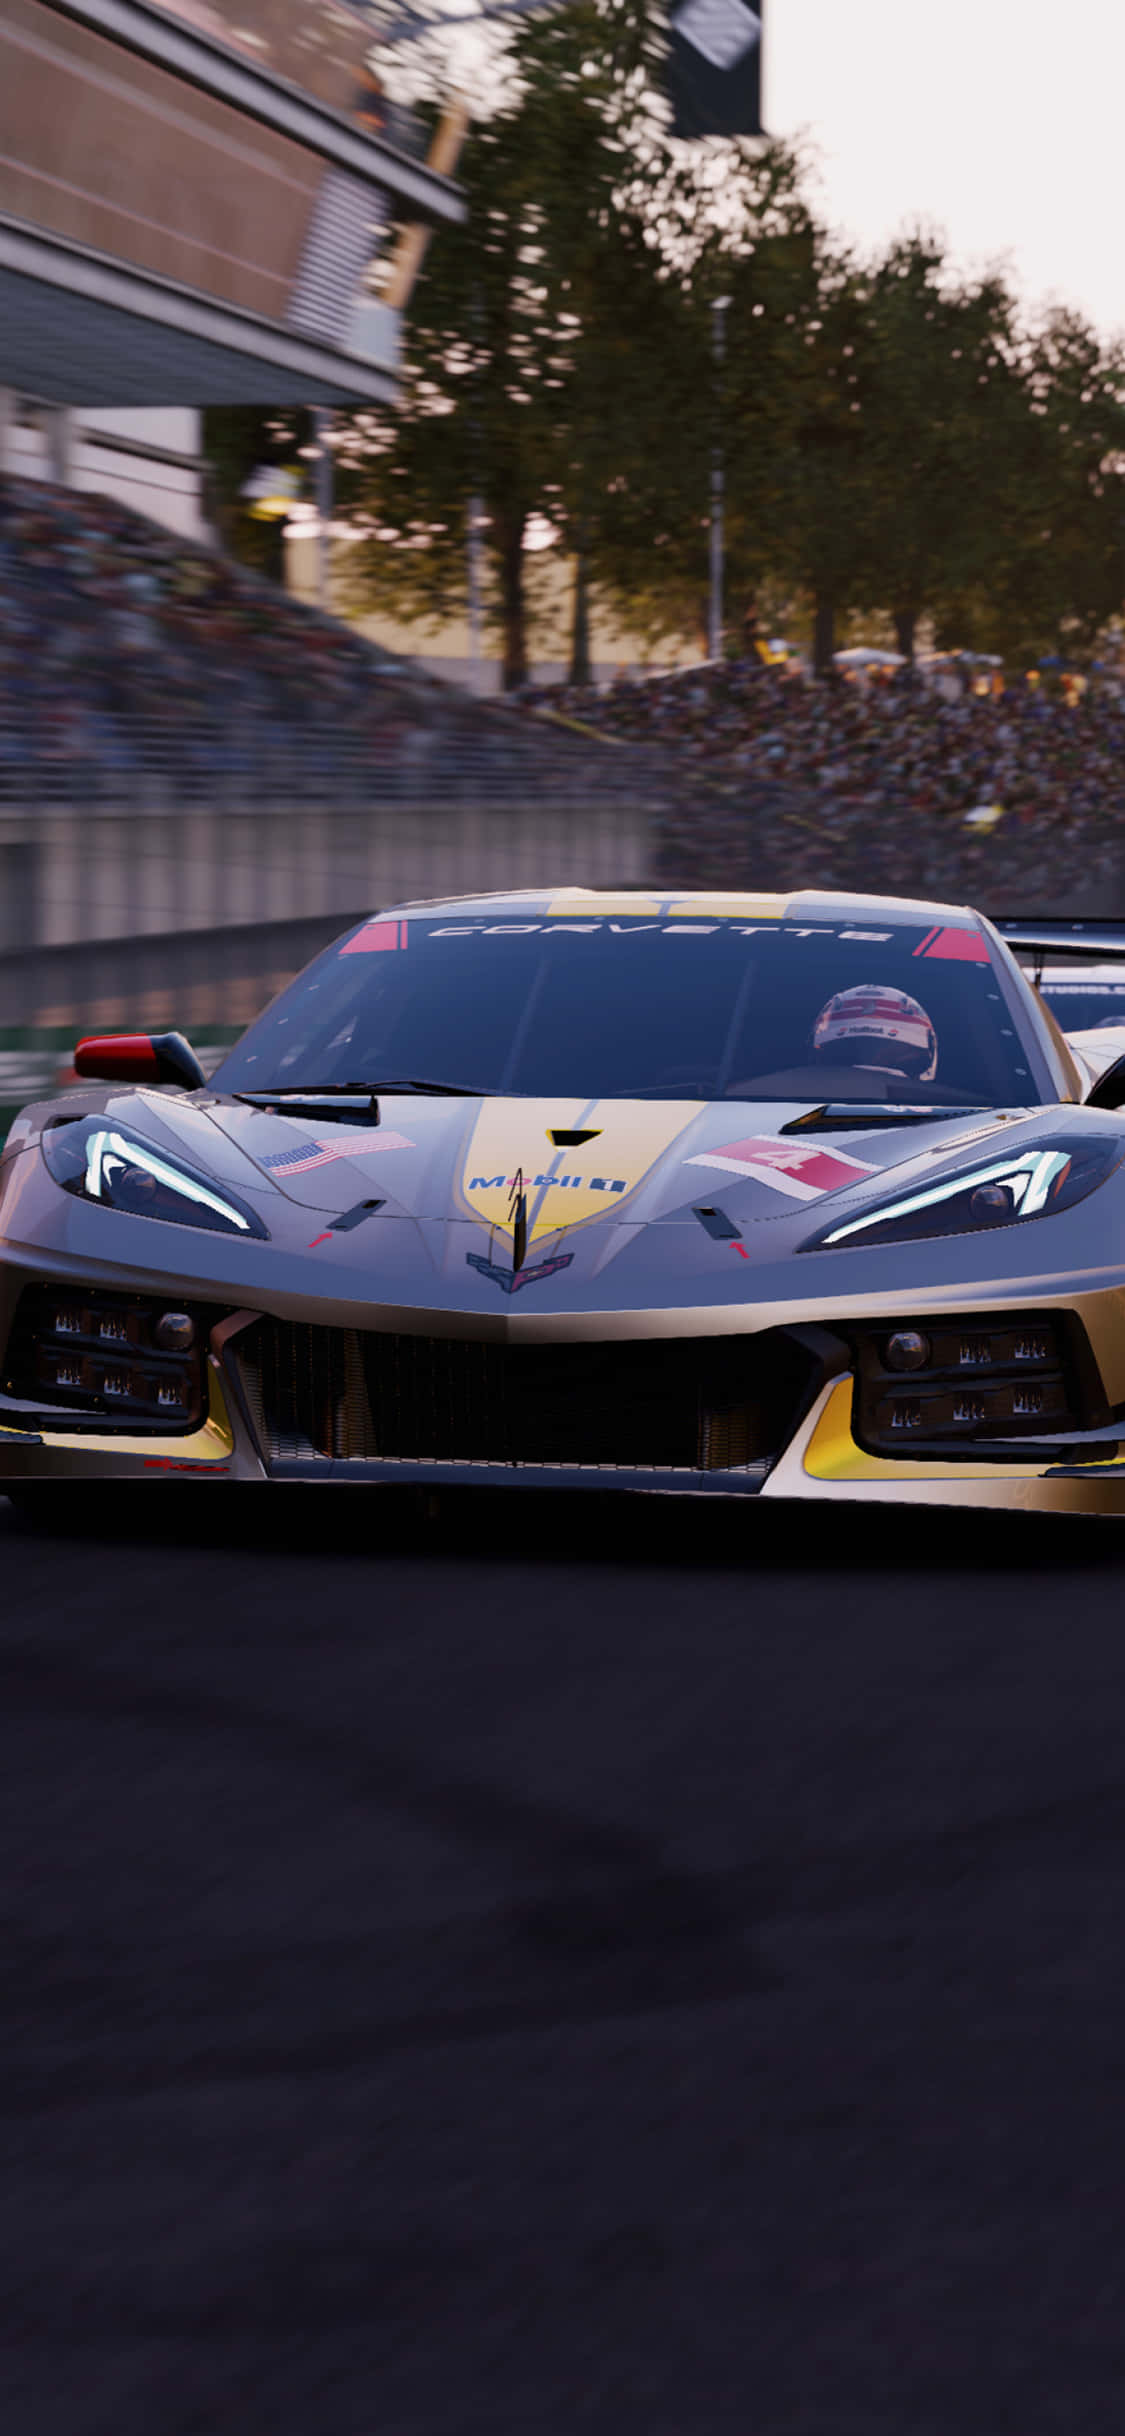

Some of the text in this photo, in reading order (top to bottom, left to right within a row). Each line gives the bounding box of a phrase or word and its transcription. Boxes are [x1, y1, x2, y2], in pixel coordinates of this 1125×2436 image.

[427, 923, 895, 942] CORVETTE
[751, 1149, 821, 1170] 4
[468, 1174, 582, 1190] Mobil
